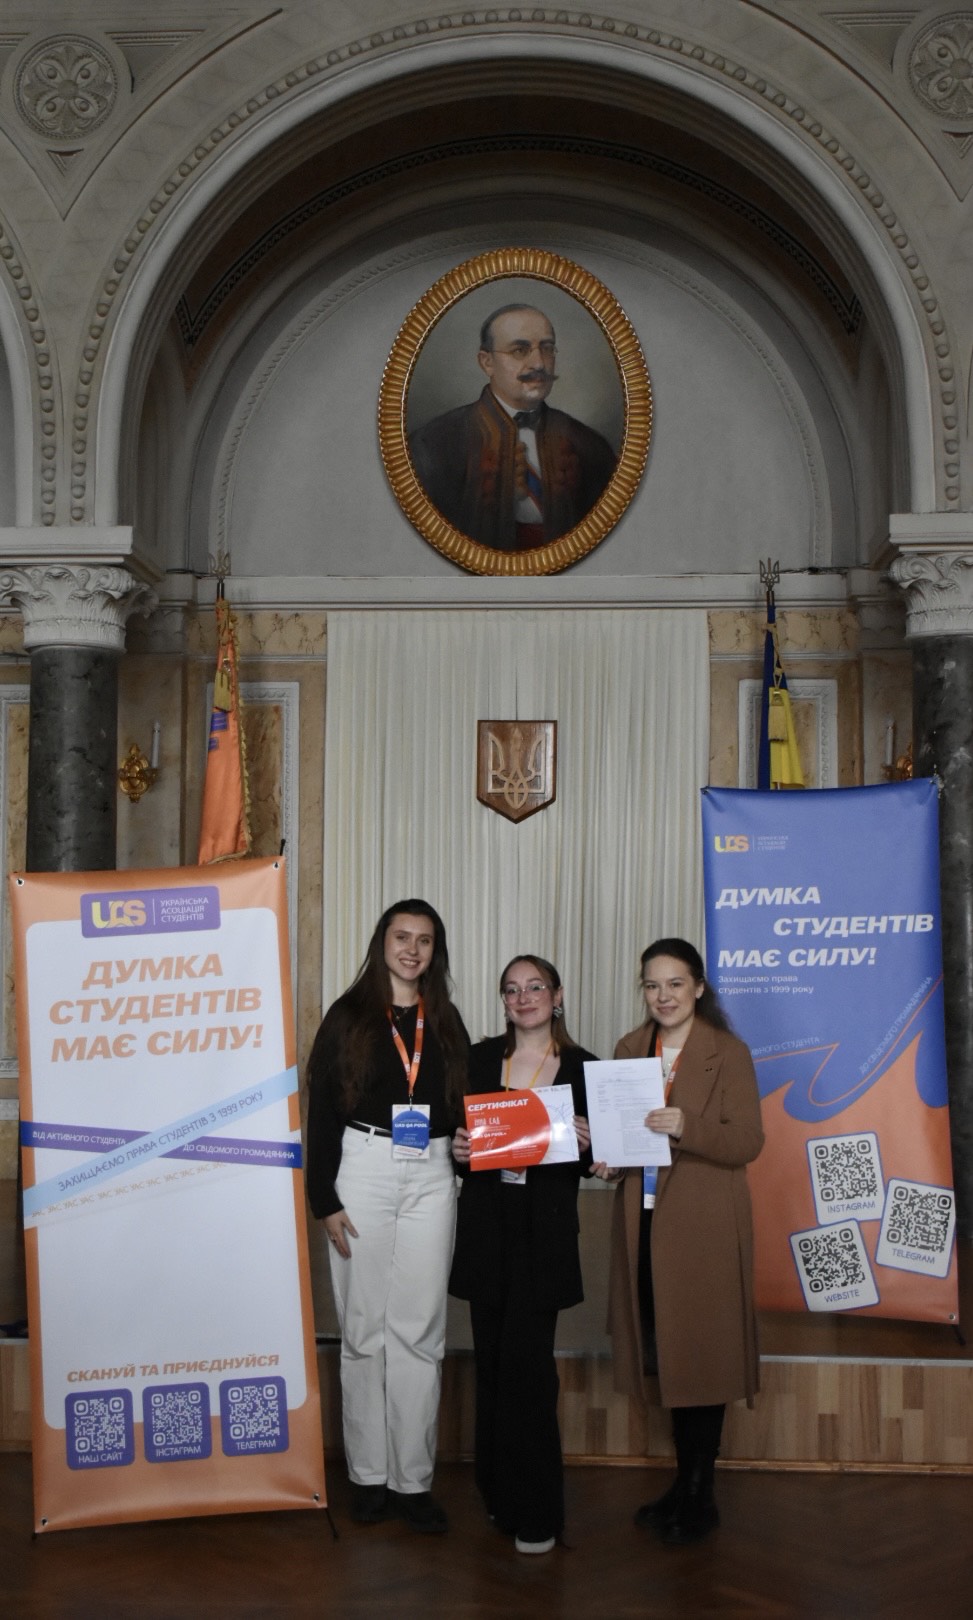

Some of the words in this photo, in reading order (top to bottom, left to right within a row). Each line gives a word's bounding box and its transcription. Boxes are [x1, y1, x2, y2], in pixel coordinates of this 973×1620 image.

[160, 896, 209, 908] УКРАЇНСЬКА
[715, 887, 821, 909] ДУМКА
[161, 905, 204, 915] АСОЦІАЦІЯ
[161, 914, 204, 923] СТУДЕНТІВ
[774, 914, 934, 938] СТУДЕНТІВ
[718, 949, 781, 968] МАЄ
[788, 947, 876, 967] СИЛУ!
[82, 953, 223, 990] ДУМКА
[718, 976, 769, 984] Захищаємо
[772, 976, 798, 984] права
[718, 986, 761, 994] студентів
[792, 986, 814, 995] року
[50, 987, 262, 1025] СТУДЕНТІВ
[51, 1034, 136, 1062] МАЄ
[147, 1024, 264, 1056] СИЛУ!
[468, 1098, 528, 1112] СЕРТИФІКАТ
[33, 1131, 46, 1139] ВІД
[47, 1132, 90, 1143] АКТИВНОГО
[90, 1135, 126, 1146] СТУДЕНТА
[58, 1155, 125, 1192] ЗАХИЩАЄМО
[126, 1140, 158, 1160] ПРАВА
[158, 1116, 208, 1145] СТУДЕНТІВ
[217, 1103, 238, 1118] 1999
[238, 1090, 263, 1109] РОКУ
[196, 1144, 239, 1154] СВІДОМОГО
[240, 1148, 295, 1159] ГРОМАДЯНИНА
[828, 1201, 876, 1214] INSTAGRAM
[892, 1248, 935, 1265] TELEGRAM
[824, 1289, 860, 1303] WEBSITE
[67, 1364, 135, 1383] СКАНУЙ
[140, 1365, 159, 1377] ТА
[163, 1354, 280, 1375] ПРИЄДНУЙСЯ
[156, 1446, 201, 1457] ІНСТАГРАМ
[236, 1439, 276, 1450] ТЕЛЕГРАМ
[78, 1454, 99, 1464] НАШ
[101, 1451, 123, 1462] САЙТ
